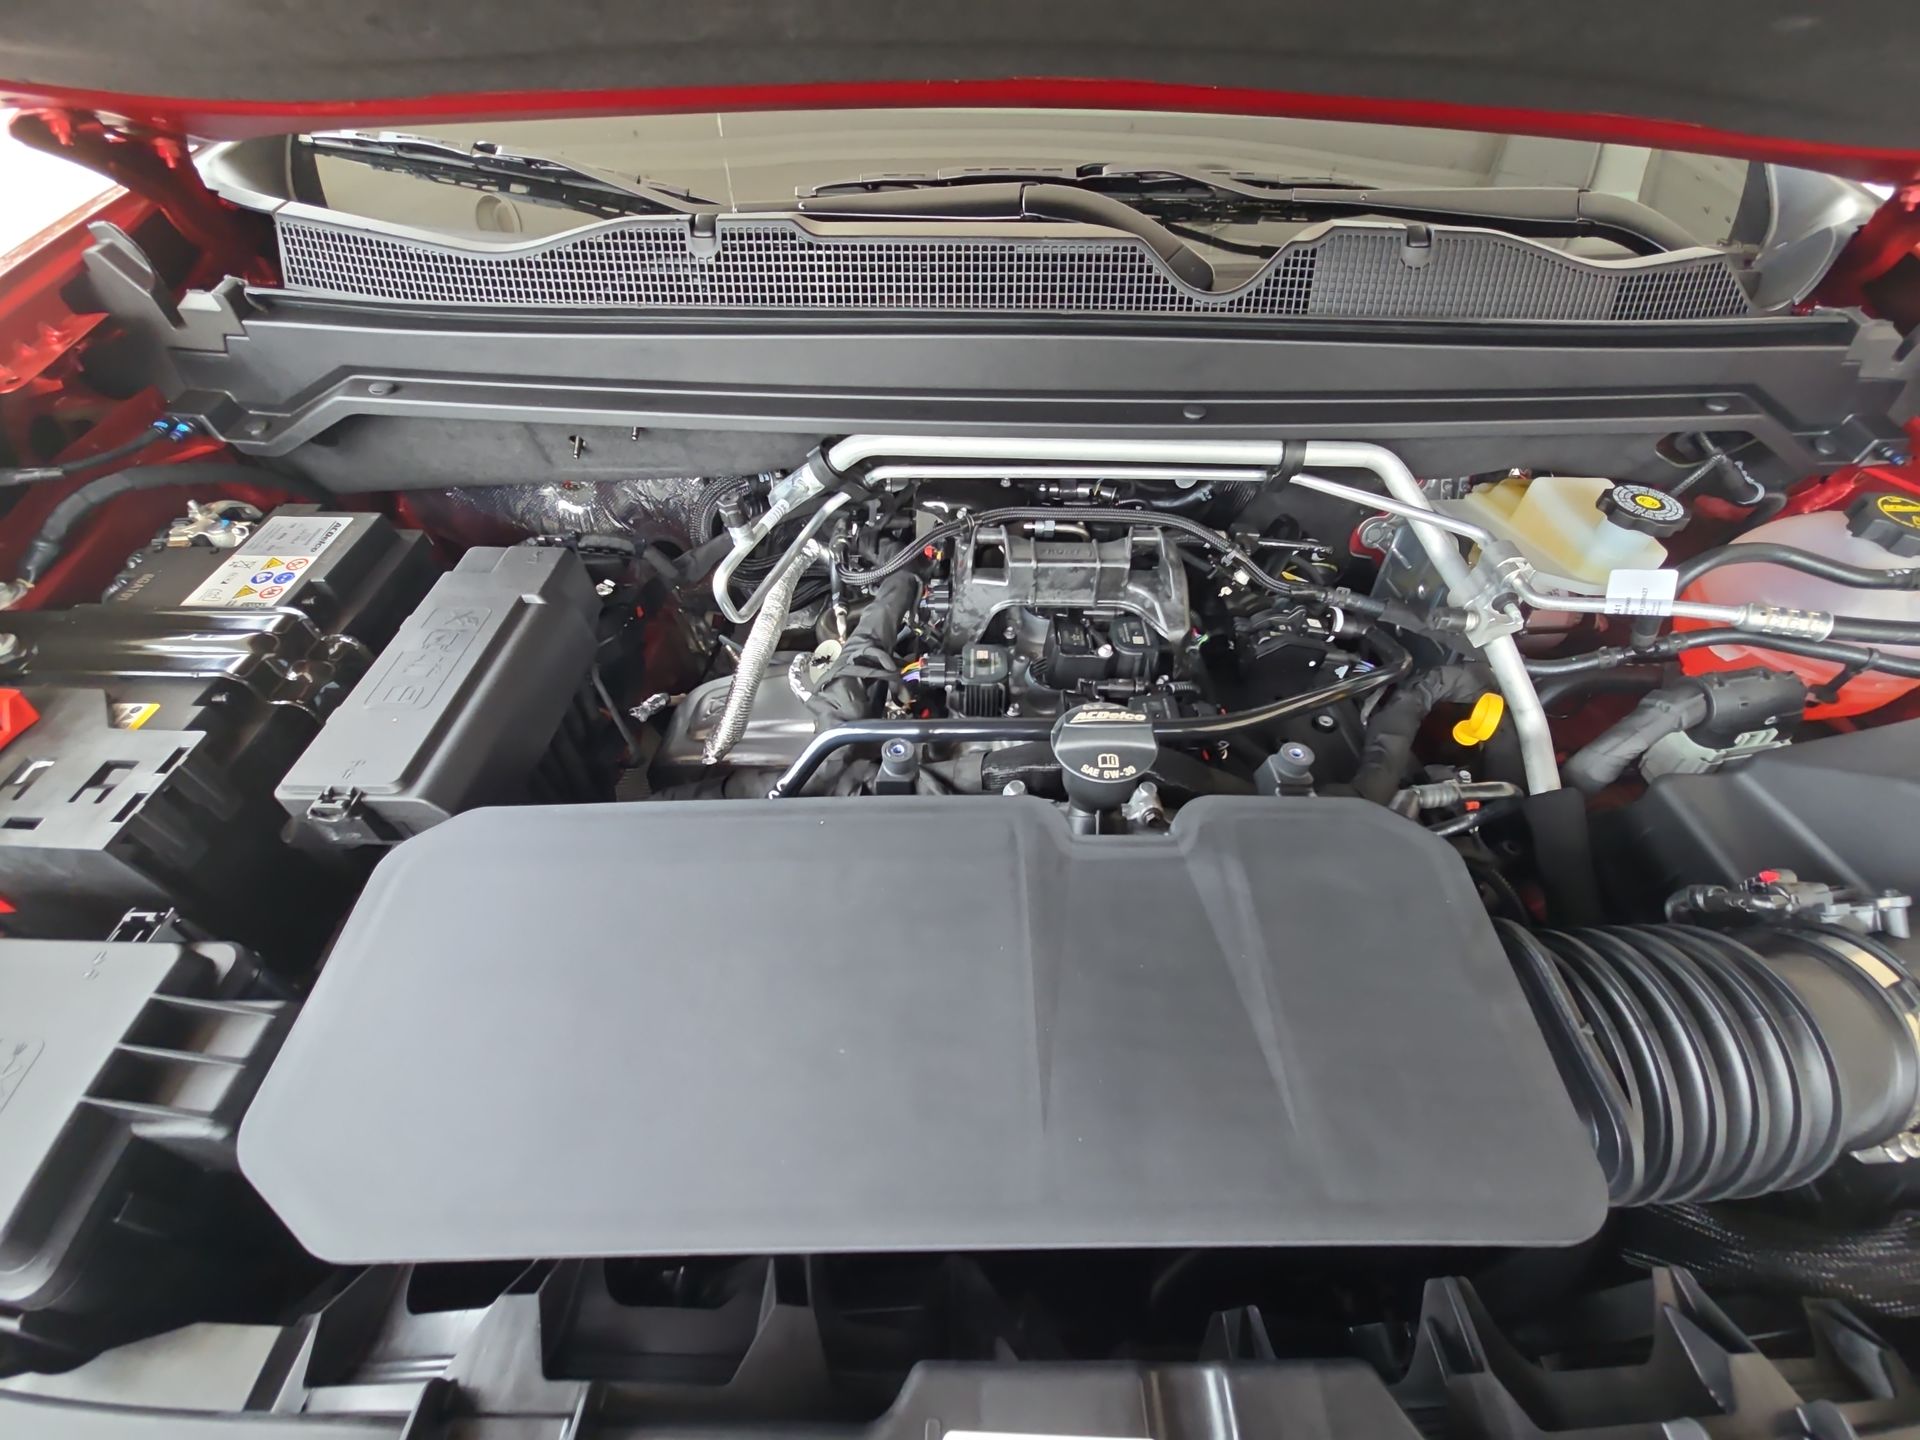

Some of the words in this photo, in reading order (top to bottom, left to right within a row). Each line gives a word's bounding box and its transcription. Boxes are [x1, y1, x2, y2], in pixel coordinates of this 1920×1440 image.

[310, 522, 342, 552] ACDelco
[1075, 711, 1147, 722] ACDelco
[1080, 764, 1100, 778] SAE
[1103, 765, 1137, 779] 5W-30
